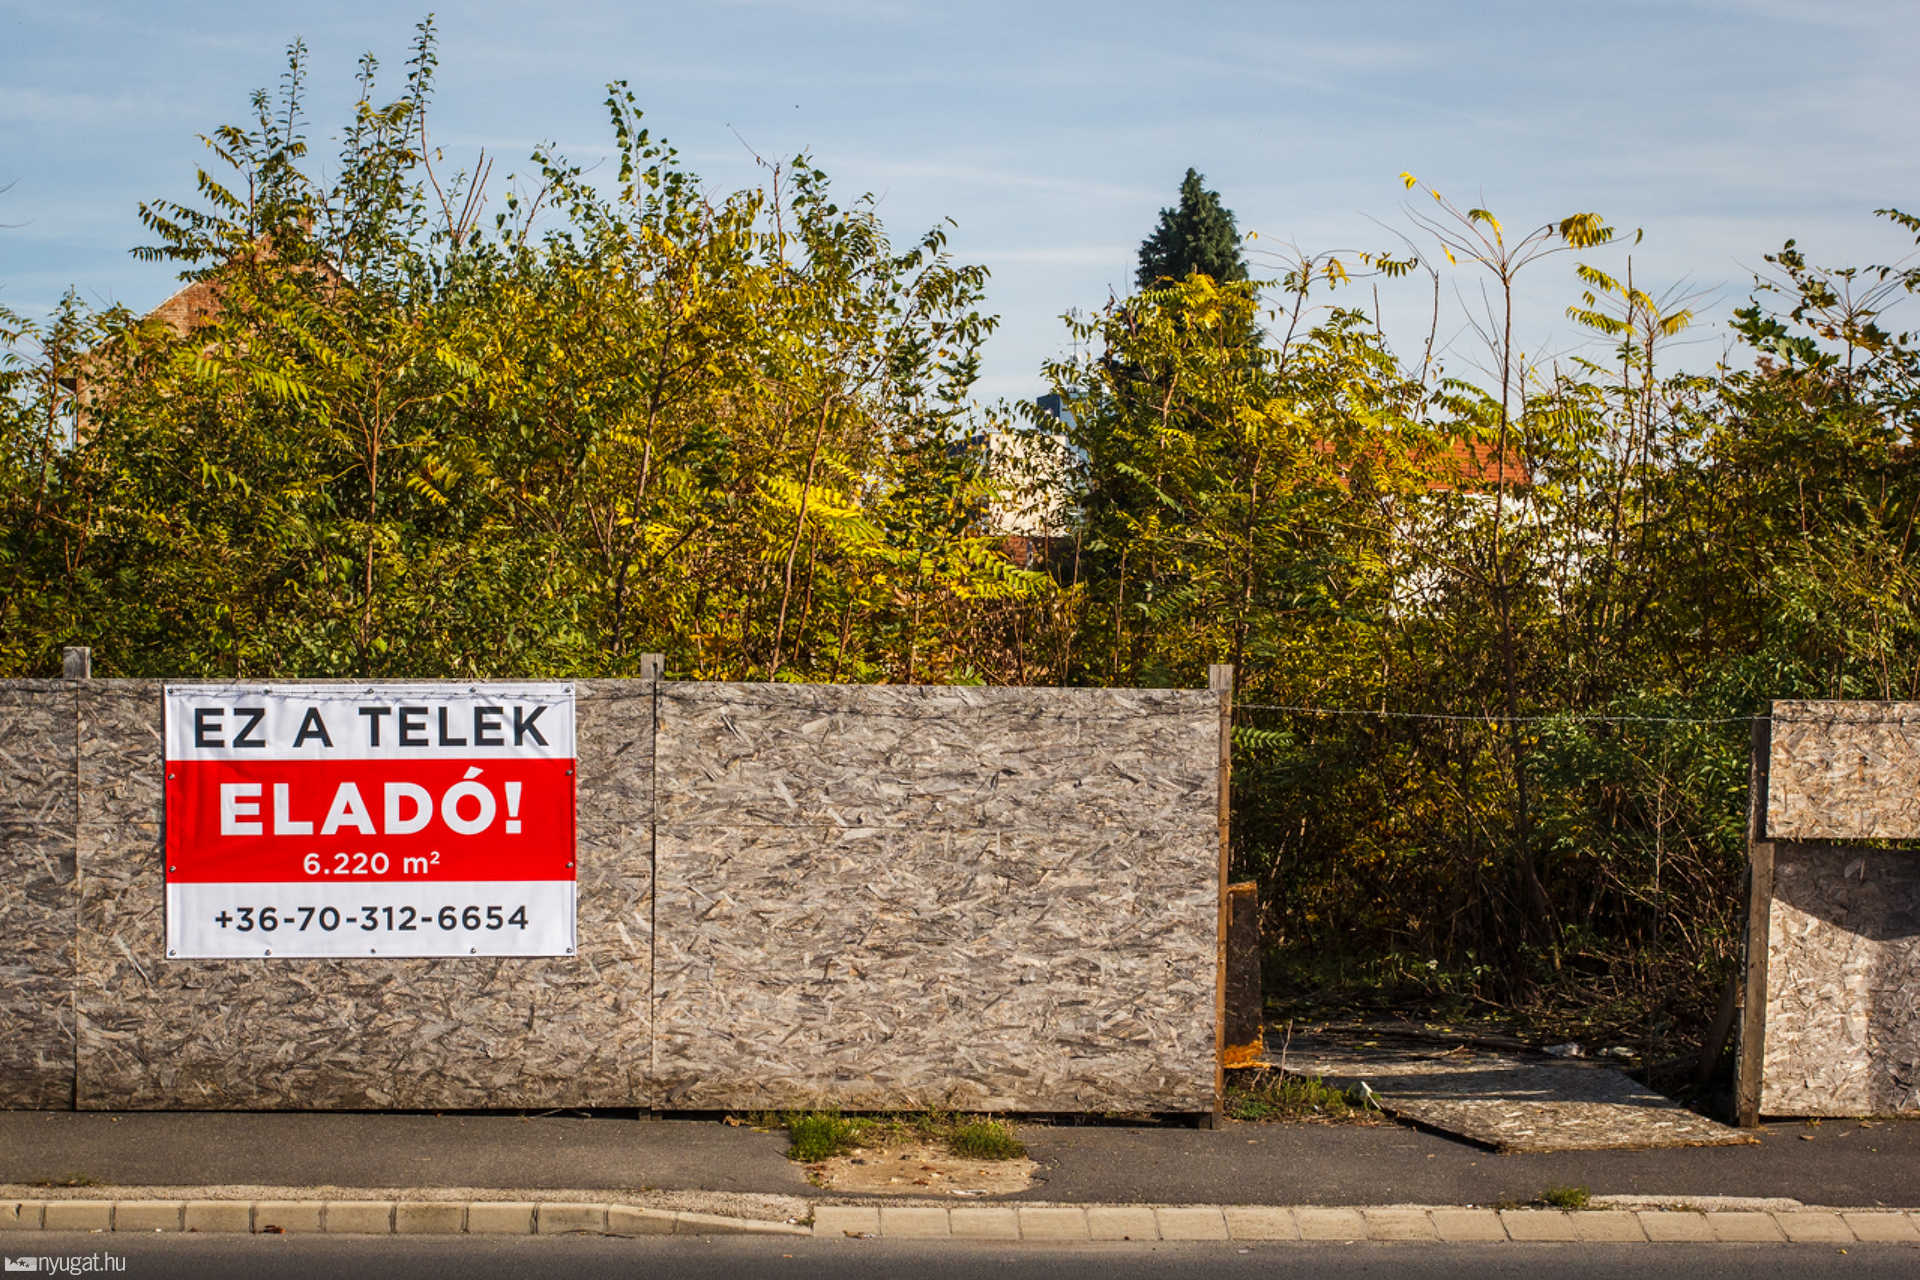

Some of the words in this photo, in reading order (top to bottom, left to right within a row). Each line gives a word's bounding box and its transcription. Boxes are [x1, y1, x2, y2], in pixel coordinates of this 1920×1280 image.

[194, 707, 266, 748] EZ
[292, 707, 334, 748] A
[358, 705, 549, 747] TELEK
[220, 765, 522, 836] ELADÓ!
[303, 852, 390, 875] 6.220
[215, 905, 529, 932] +36-70-312-6654
